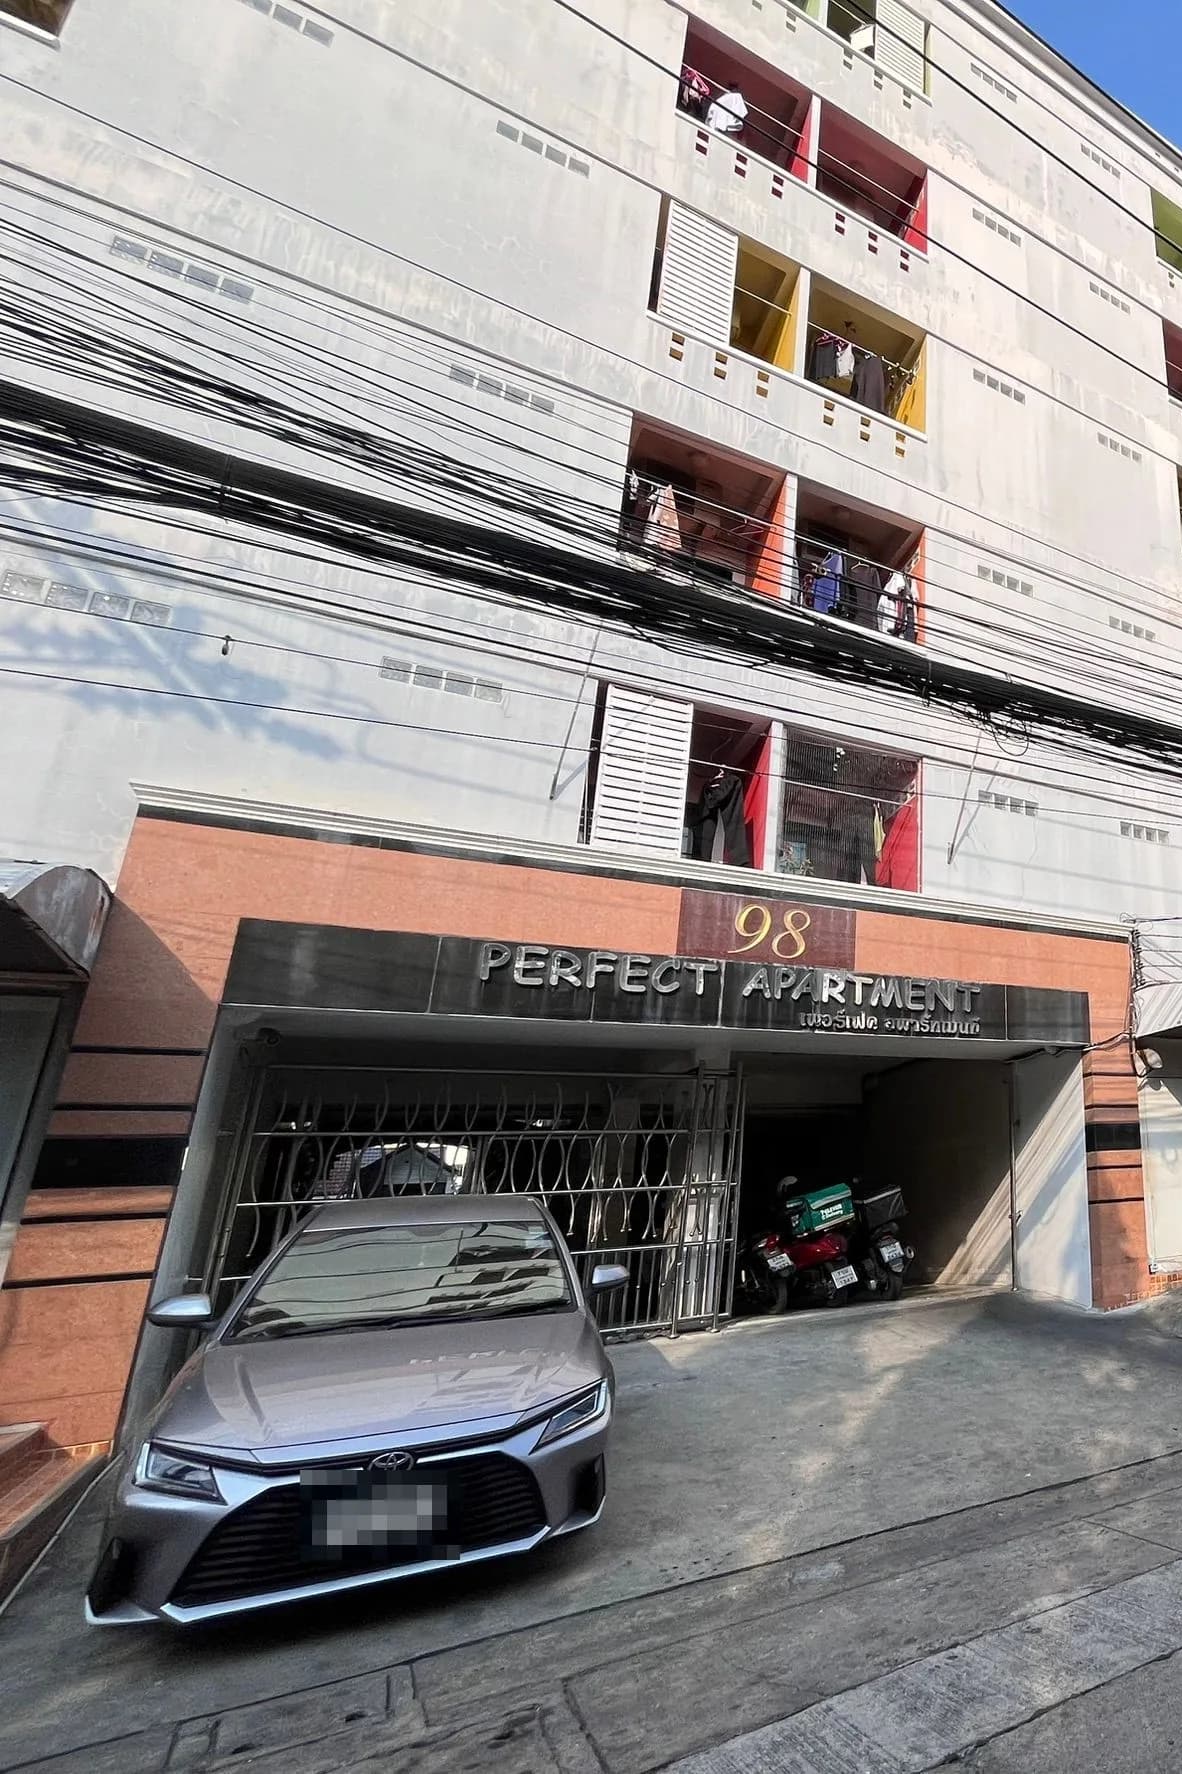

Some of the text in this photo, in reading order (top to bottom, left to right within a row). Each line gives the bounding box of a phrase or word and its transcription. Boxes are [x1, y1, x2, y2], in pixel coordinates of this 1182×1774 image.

[727, 904, 811, 959] 98
[479, 942, 982, 1013] PERFECT APARTMENT
